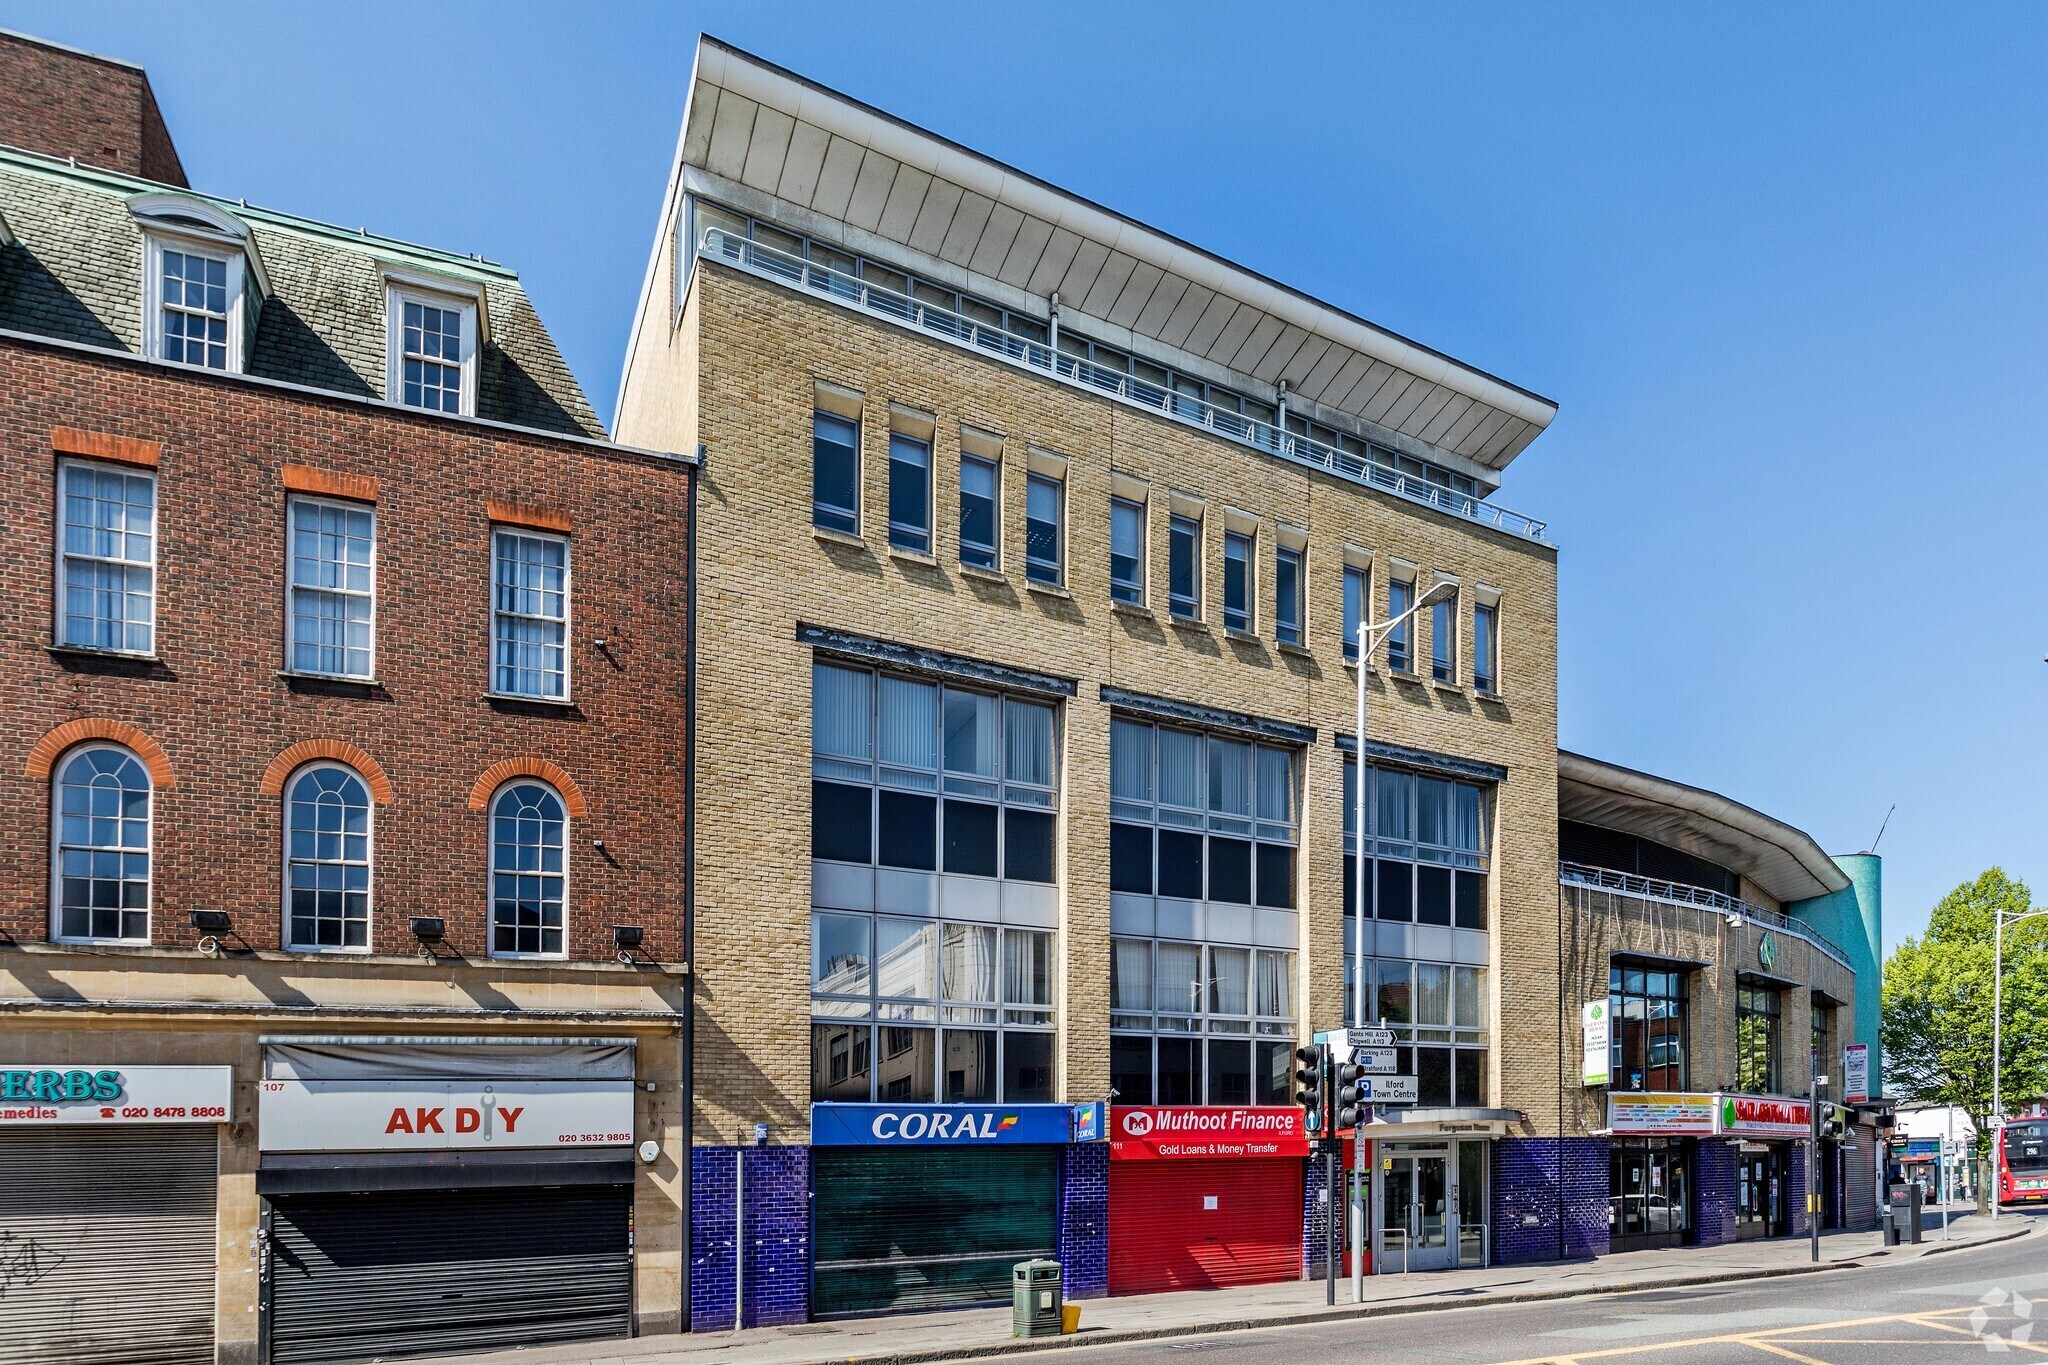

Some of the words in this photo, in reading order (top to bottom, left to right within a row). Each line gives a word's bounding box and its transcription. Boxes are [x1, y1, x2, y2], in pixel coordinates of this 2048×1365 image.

[1360, 1049, 1379, 1057] Barking
[0, 1070, 122, 1103] ERBS
[264, 1083, 285, 1091] 107
[1385, 1080, 1404, 1088] Ilford
[1373, 1090, 1391, 1098] Town
[1393, 1090, 1416, 1098] Centre
[0, 1106, 57, 1119] emedies
[122, 1107, 148, 1118] 020
[153, 1107, 186, 1117] 8478
[191, 1106, 225, 1117] 8808
[384, 1107, 445, 1134] AK
[1155, 1110, 1226, 1130] Muthoot
[1231, 1109, 1294, 1130] Finance
[872, 1113, 998, 1140] CORAL
[1439, 1123, 1472, 1133] Ferguson
[558, 1134, 577, 1143] 020
[580, 1133, 604, 1142] 3632
[606, 1132, 631, 1141] 9805
[1077, 1129, 1095, 1139] CORAL
[1113, 1142, 1123, 1150] 111
[1159, 1144, 1179, 1155] Gold
[1181, 1143, 1207, 1155] Loans
[1208, 1144, 1215, 1154] &
[1217, 1143, 1243, 1156] Money
[1246, 1142, 1278, 1153] Transfer
